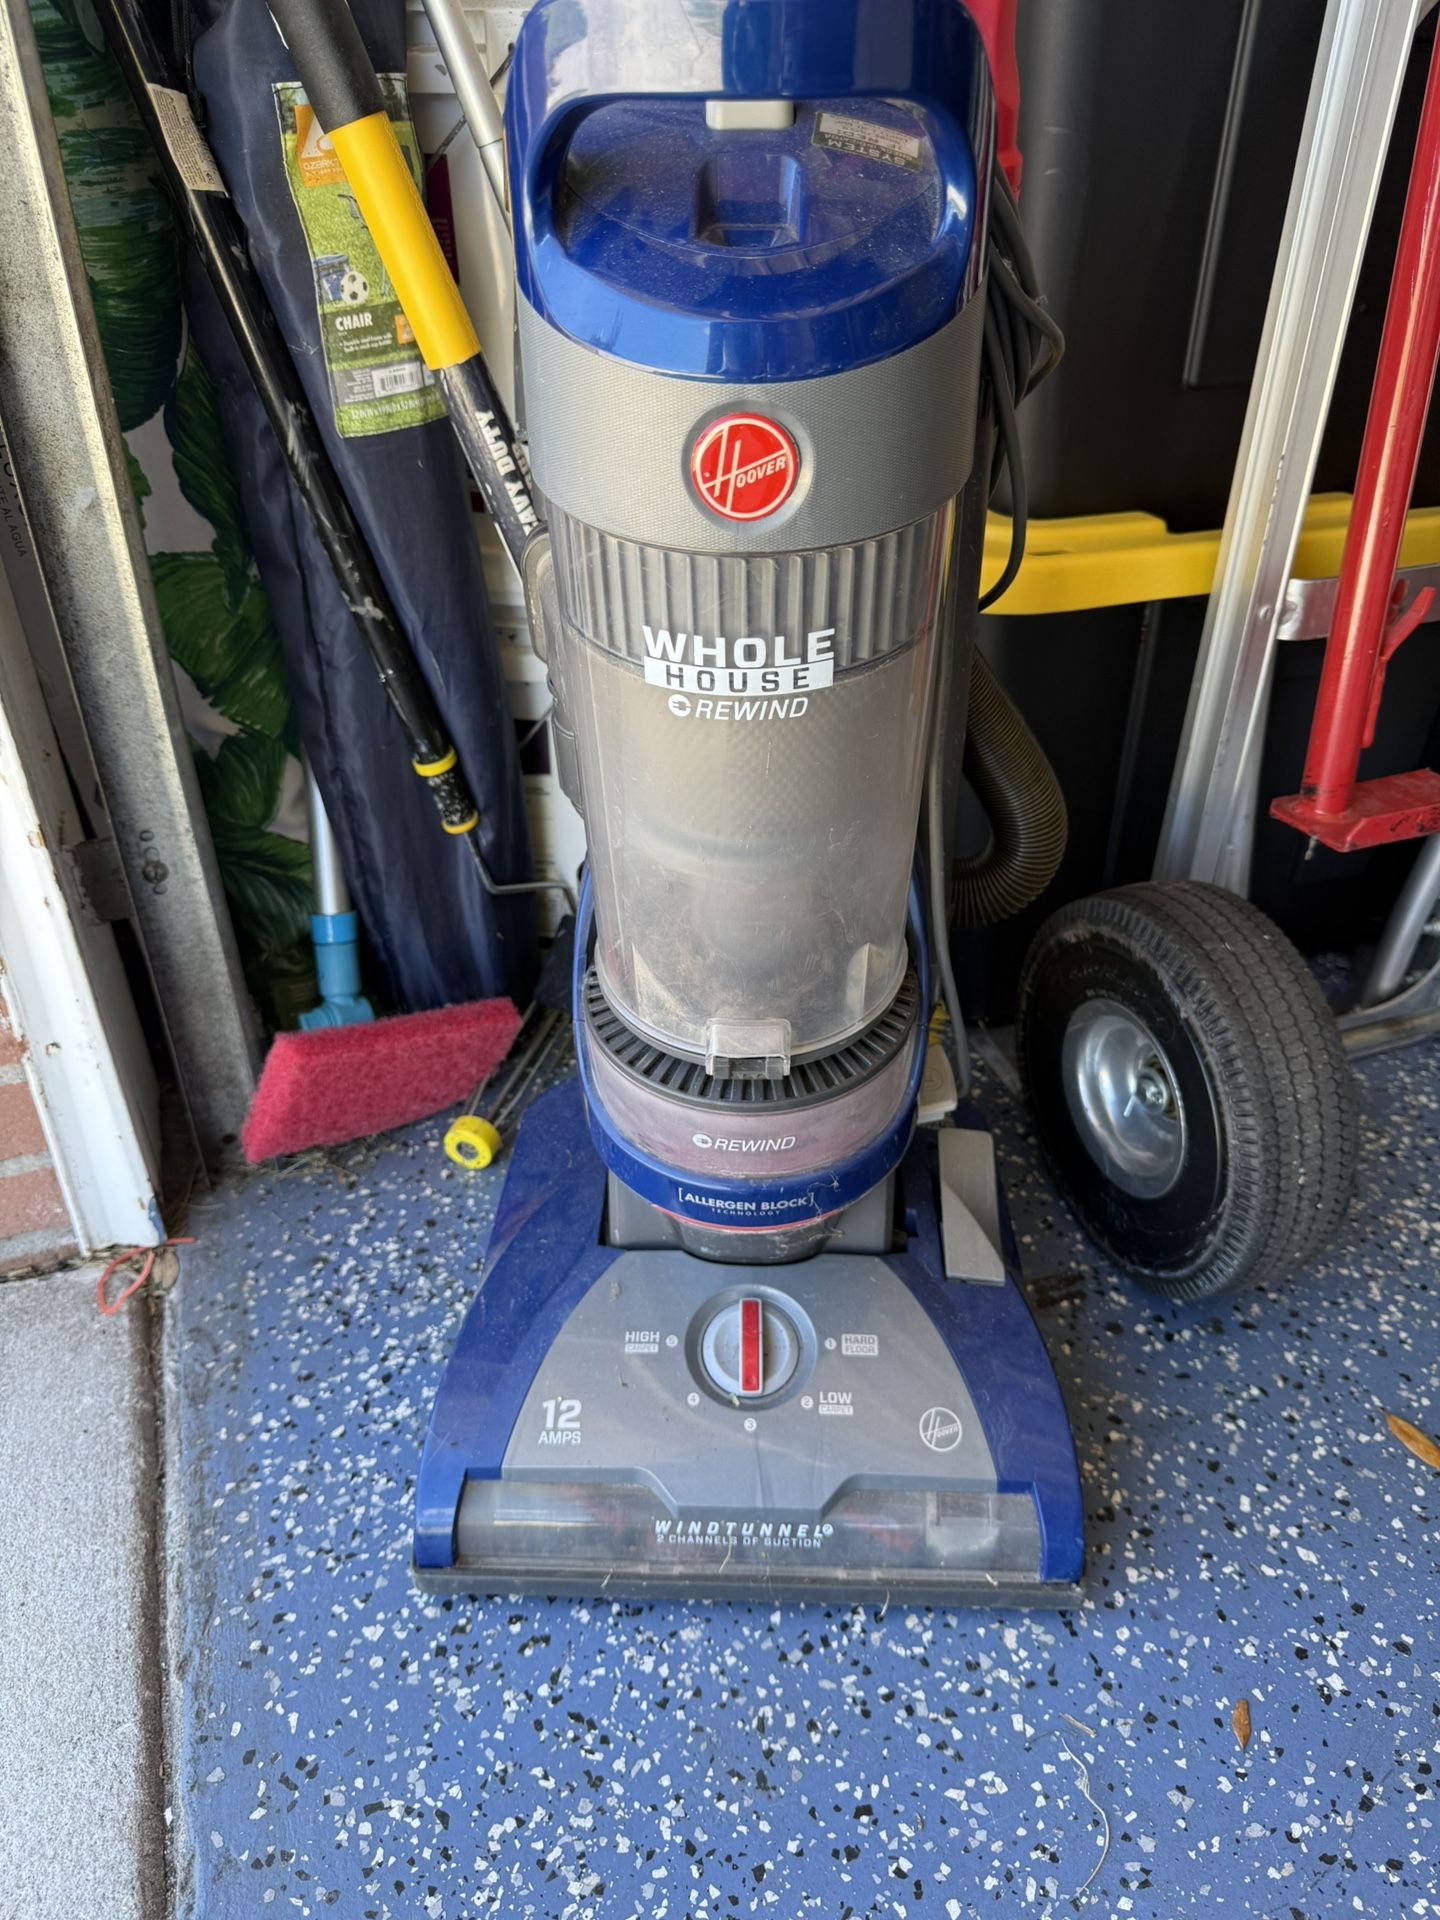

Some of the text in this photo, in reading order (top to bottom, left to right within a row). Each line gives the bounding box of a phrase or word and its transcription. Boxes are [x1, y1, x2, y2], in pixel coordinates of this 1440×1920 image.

[826, 138, 905, 165] SYSTEM
[335, 312, 373, 331] CHAIR
[475, 410, 515, 476] DUTY
[703, 424, 787, 511] HOOVER
[504, 481, 539, 536] EAVY
[8, 524, 28, 557] AGUA
[642, 625, 835, 668] WHOLE
[666, 664, 810, 692] HOUSE
[695, 697, 809, 720] REWIND
[714, 1136, 796, 1152] REWIND
[712, 1208, 780, 1216] TECHNOLOGY
[625, 1331, 660, 1342] HIGH
[845, 1335, 876, 1344] HARD
[819, 1391, 852, 1404] LOW
[543, 1399, 582, 1428] 12
[538, 1430, 582, 1444] AMPS
[655, 1520, 823, 1538] WINDTUNNEL
[669, 1535, 737, 1545] CHANNELS
[743, 1536, 758, 1545] OF
[764, 1537, 822, 1548] SUCTION
